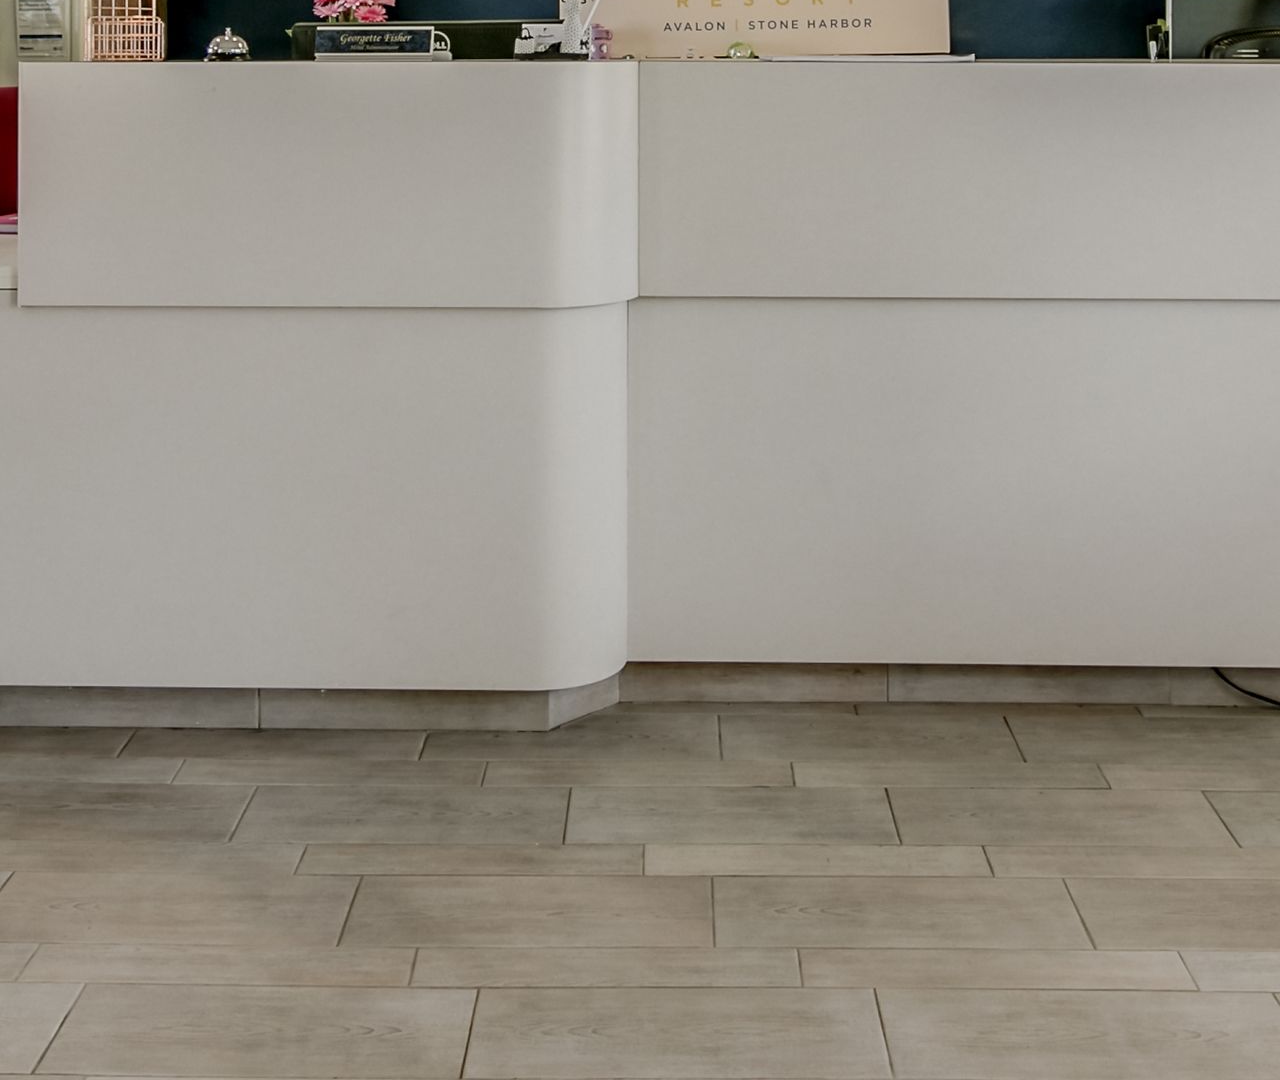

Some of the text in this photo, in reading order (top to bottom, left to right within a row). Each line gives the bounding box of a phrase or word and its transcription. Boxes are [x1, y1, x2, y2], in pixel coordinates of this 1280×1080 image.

[663, 18, 873, 32] AVALON STONE HARBOR
[340, 33, 412, 45] Georgette Fisher
